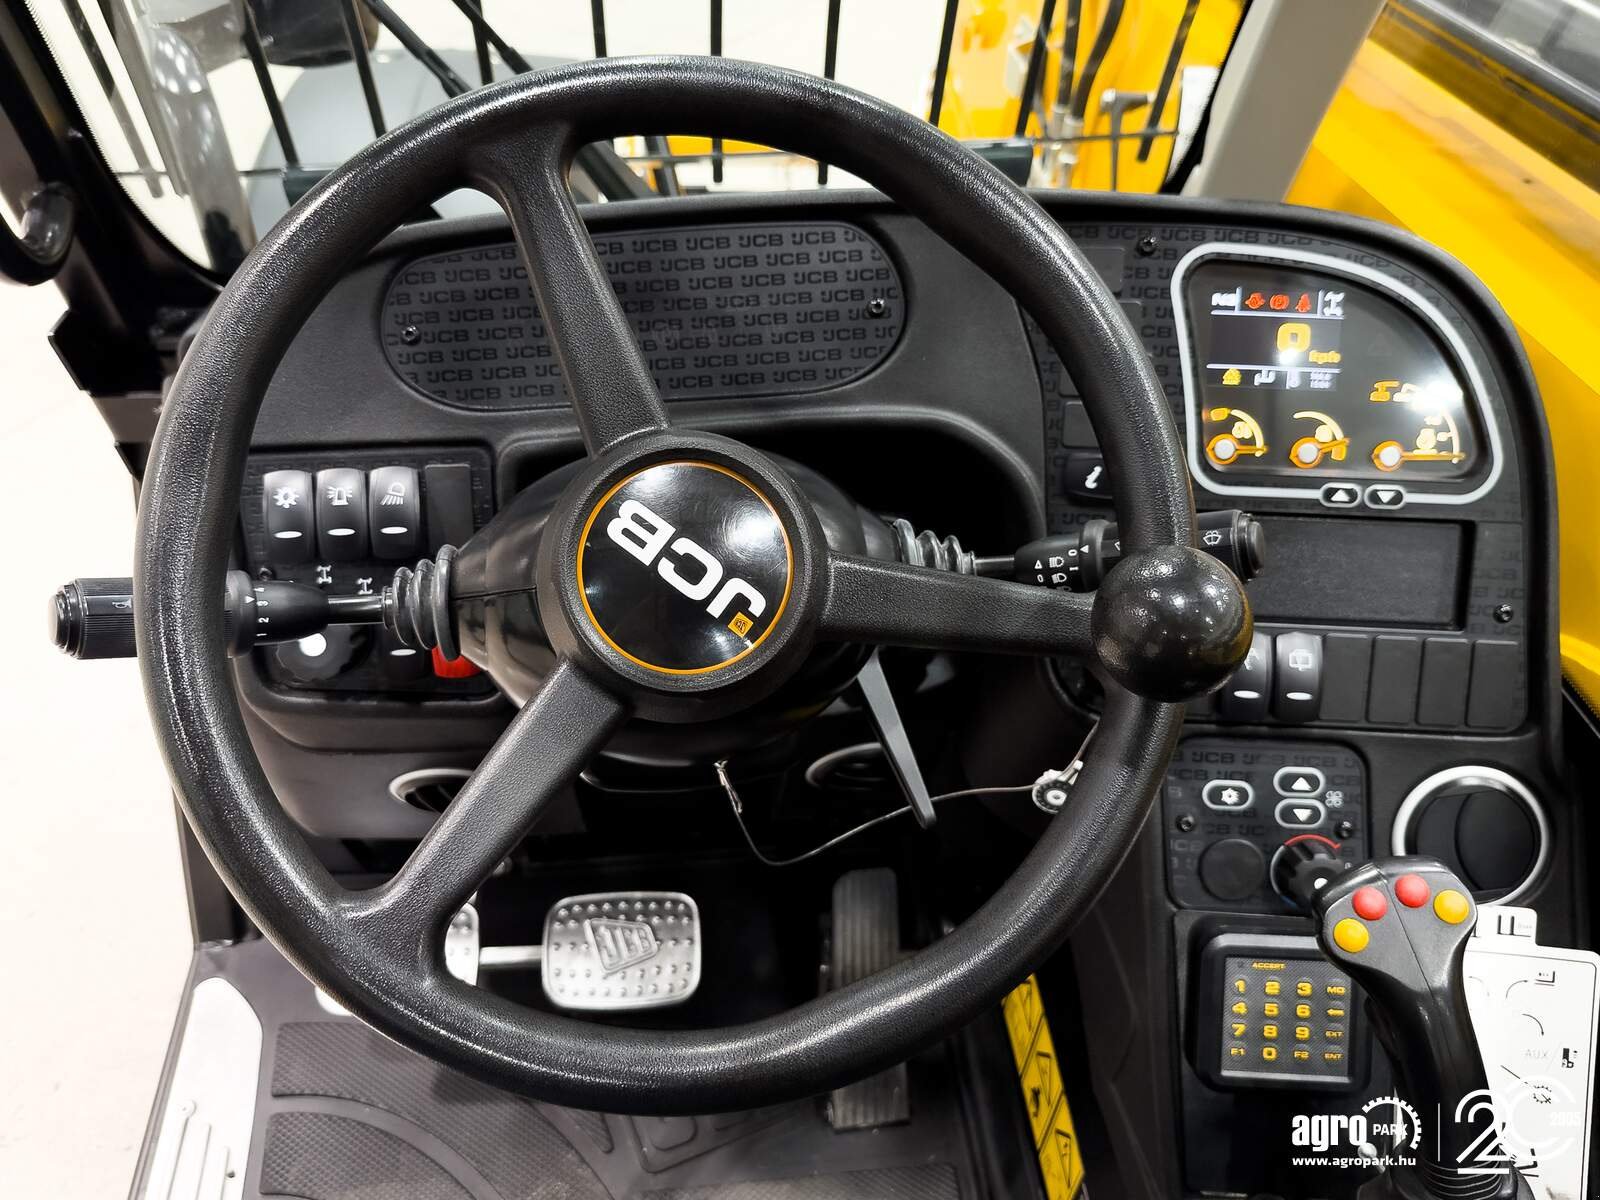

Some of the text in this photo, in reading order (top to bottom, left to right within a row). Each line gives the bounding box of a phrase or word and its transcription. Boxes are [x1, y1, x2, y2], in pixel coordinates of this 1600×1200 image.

[594, 242, 624, 255] CB
[632, 240, 678, 253] JCB
[686, 237, 731, 250] JCB
[739, 234, 784, 248] JCB
[792, 231, 836, 245] JCB
[1070, 225, 1099, 239] CB
[1161, 228, 1205, 242] JCB
[1214, 229, 1259, 244] JCB
[445, 268, 491, 283] JCB
[499, 266, 528, 280] JC
[606, 260, 652, 275] JCB
[660, 258, 705, 272] JCB
[714, 255, 758, 269] JCB
[766, 252, 810, 266] JCB
[819, 250, 863, 263] JCB
[419, 290, 467, 304] JCB
[474, 287, 520, 301] JCB
[634, 279, 680, 293] JCB
[688, 276, 733, 290] JCB
[741, 274, 786, 287] JCB
[794, 271, 838, 285] JCB
[846, 268, 890, 282] JCB
[393, 311, 440, 326] JCB
[448, 308, 494, 323] JCB
[623, 300, 655, 313] CB
[663, 297, 708, 311] JCB
[715, 295, 760, 309] JCB
[768, 292, 813, 306] JCB
[821, 288, 865, 303] JCB
[872, 286, 898, 299] JC
[423, 329, 470, 344] JCB
[477, 326, 524, 341] JCB
[638, 318, 683, 332] JCB
[691, 315, 736, 330] JCB
[743, 312, 788, 327] JCB
[796, 310, 840, 324] JCB
[1142, 325, 1171, 338] CB
[398, 351, 444, 365] JCB
[452, 348, 498, 362] JCB
[506, 345, 552, 359] JCB
[665, 336, 711, 350] JCB
[718, 334, 763, 348] JCB
[771, 331, 815, 345] JCB
[823, 328, 866, 342] JCB
[1152, 345, 1179, 358] JC
[426, 369, 473, 383] JCB
[481, 366, 527, 380] JCB
[535, 364, 561, 377] JC
[693, 354, 738, 368] JCB
[745, 351, 790, 366] JCB
[798, 348, 842, 363] JCB
[455, 387, 502, 401] JCB
[509, 384, 555, 398] JCB
[668, 375, 713, 389] JCB
[720, 372, 766, 386] JCB
[773, 369, 817, 383] JCB
[607, 499, 767, 619] JCB
[1192, 752, 1235, 764] JCB
[1294, 755, 1337, 767] JCB
[1252, 962, 1286, 970] ACCEPT
[1234, 979, 1246, 993] 1
[1265, 981, 1280, 995] 2
[1297, 982, 1312, 996] 3
[1232, 1002, 1311, 1018] 4 5 6
[1232, 1023, 1246, 1036] 7
[1263, 1024, 1278, 1038] 8
[1296, 1026, 1310, 1040] 9
[1230, 1047, 1245, 1056] F1
[1262, 1047, 1277, 1060] 0
[1294, 1051, 1309, 1059] F2
[1524, 1048, 1549, 1060] AUX
